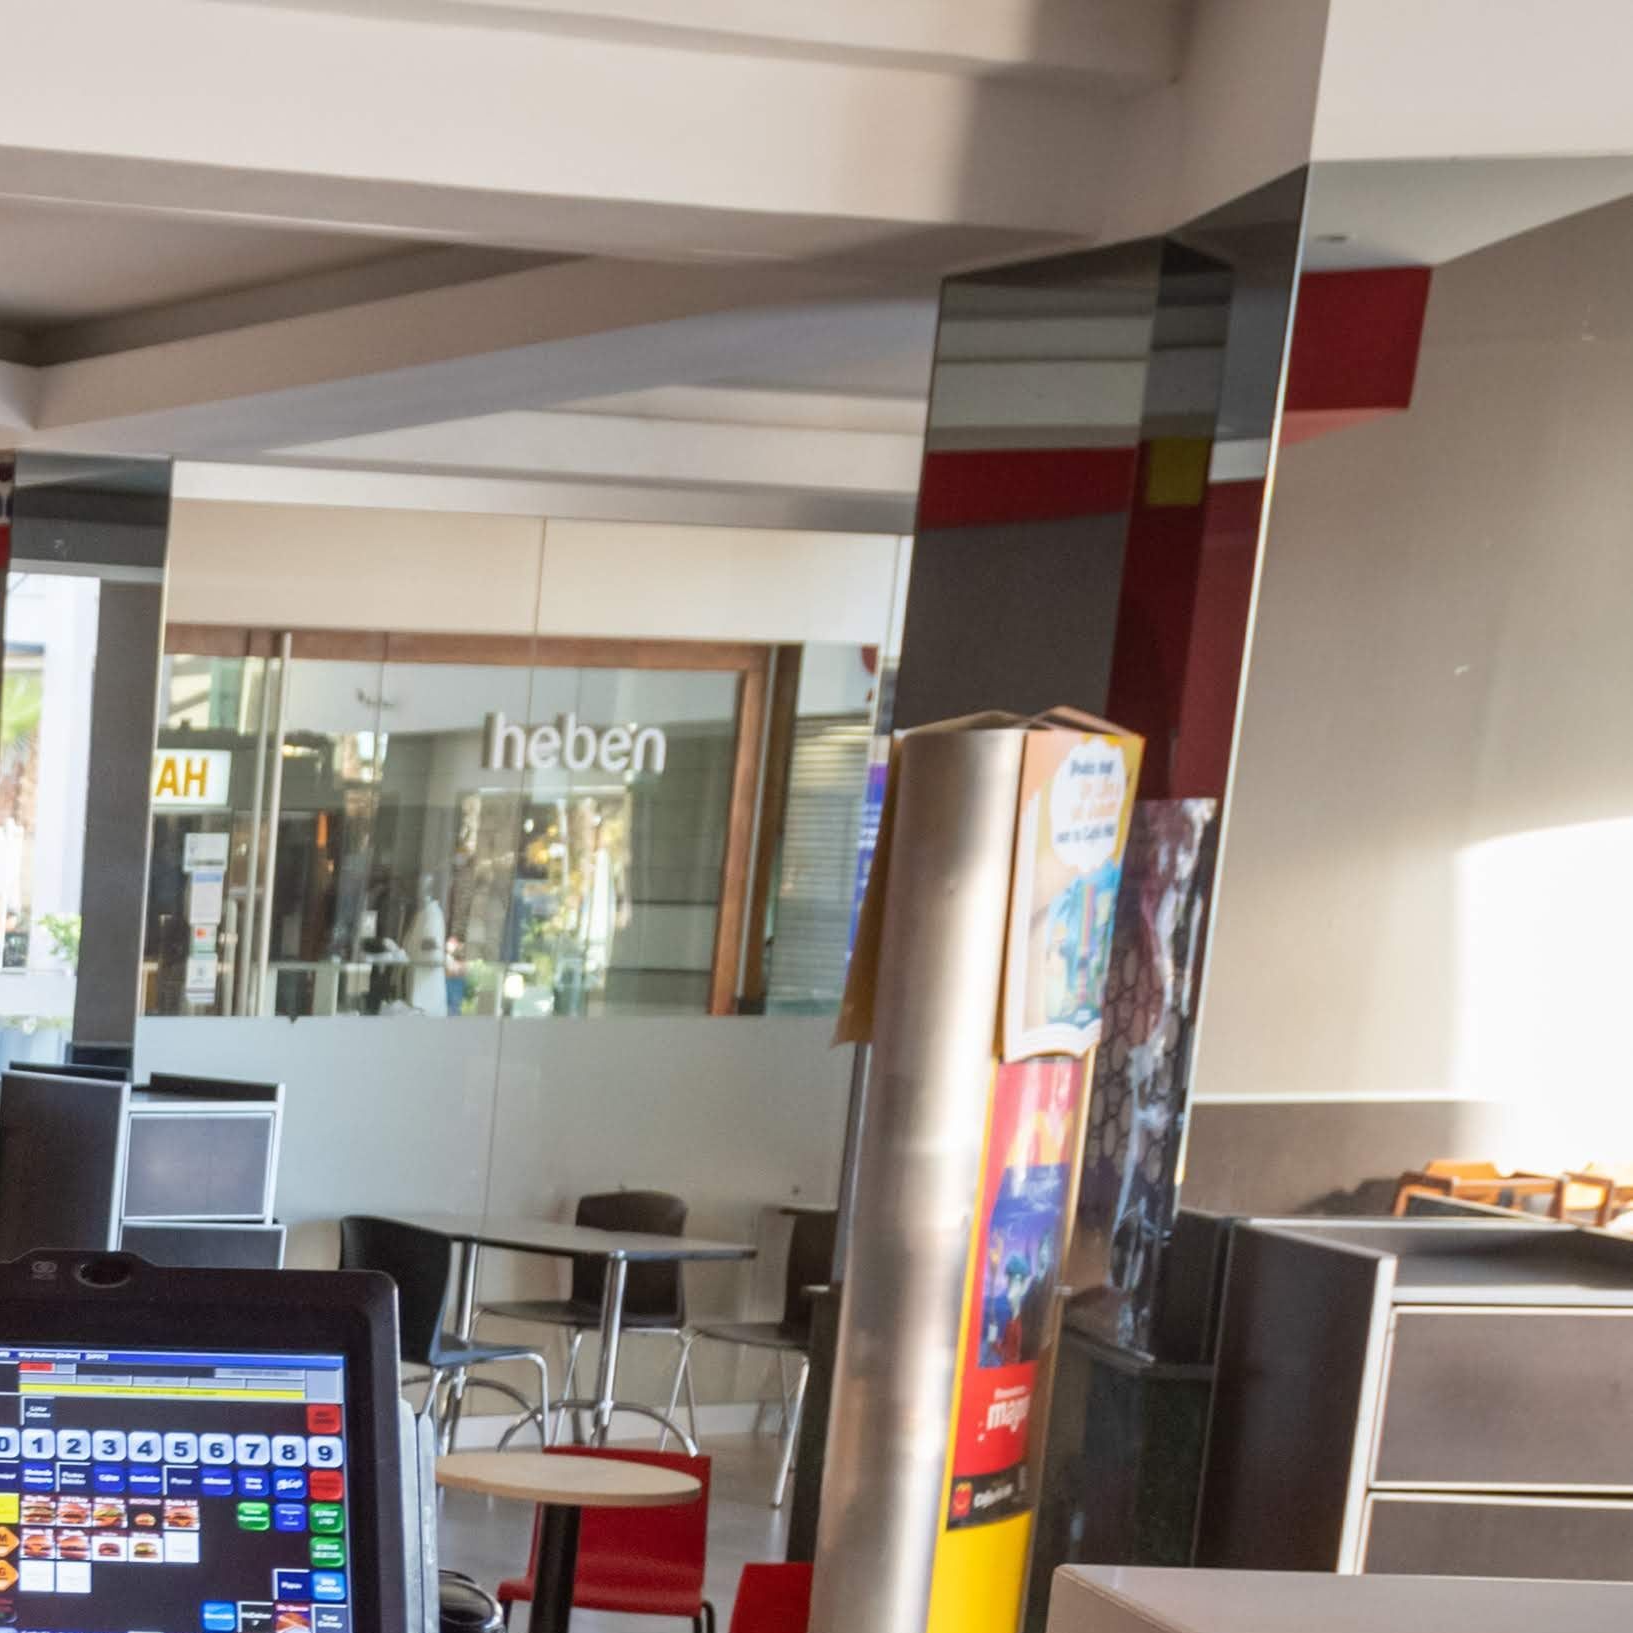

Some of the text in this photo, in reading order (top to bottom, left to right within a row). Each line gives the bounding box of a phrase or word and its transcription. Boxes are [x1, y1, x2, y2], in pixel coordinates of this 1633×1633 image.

[491, 711, 667, 772] heben
[32, 1437, 43, 1452] 1
[66, 1438, 82, 1454] 2
[101, 1439, 116, 1455] 3
[137, 1440, 152, 1456] 4
[174, 1442, 188, 1457] 5
[210, 1442, 224, 1458] 6
[245, 1443, 261, 1459] 7
[281, 1444, 296, 1460] 8
[317, 1445, 333, 1461] 9
